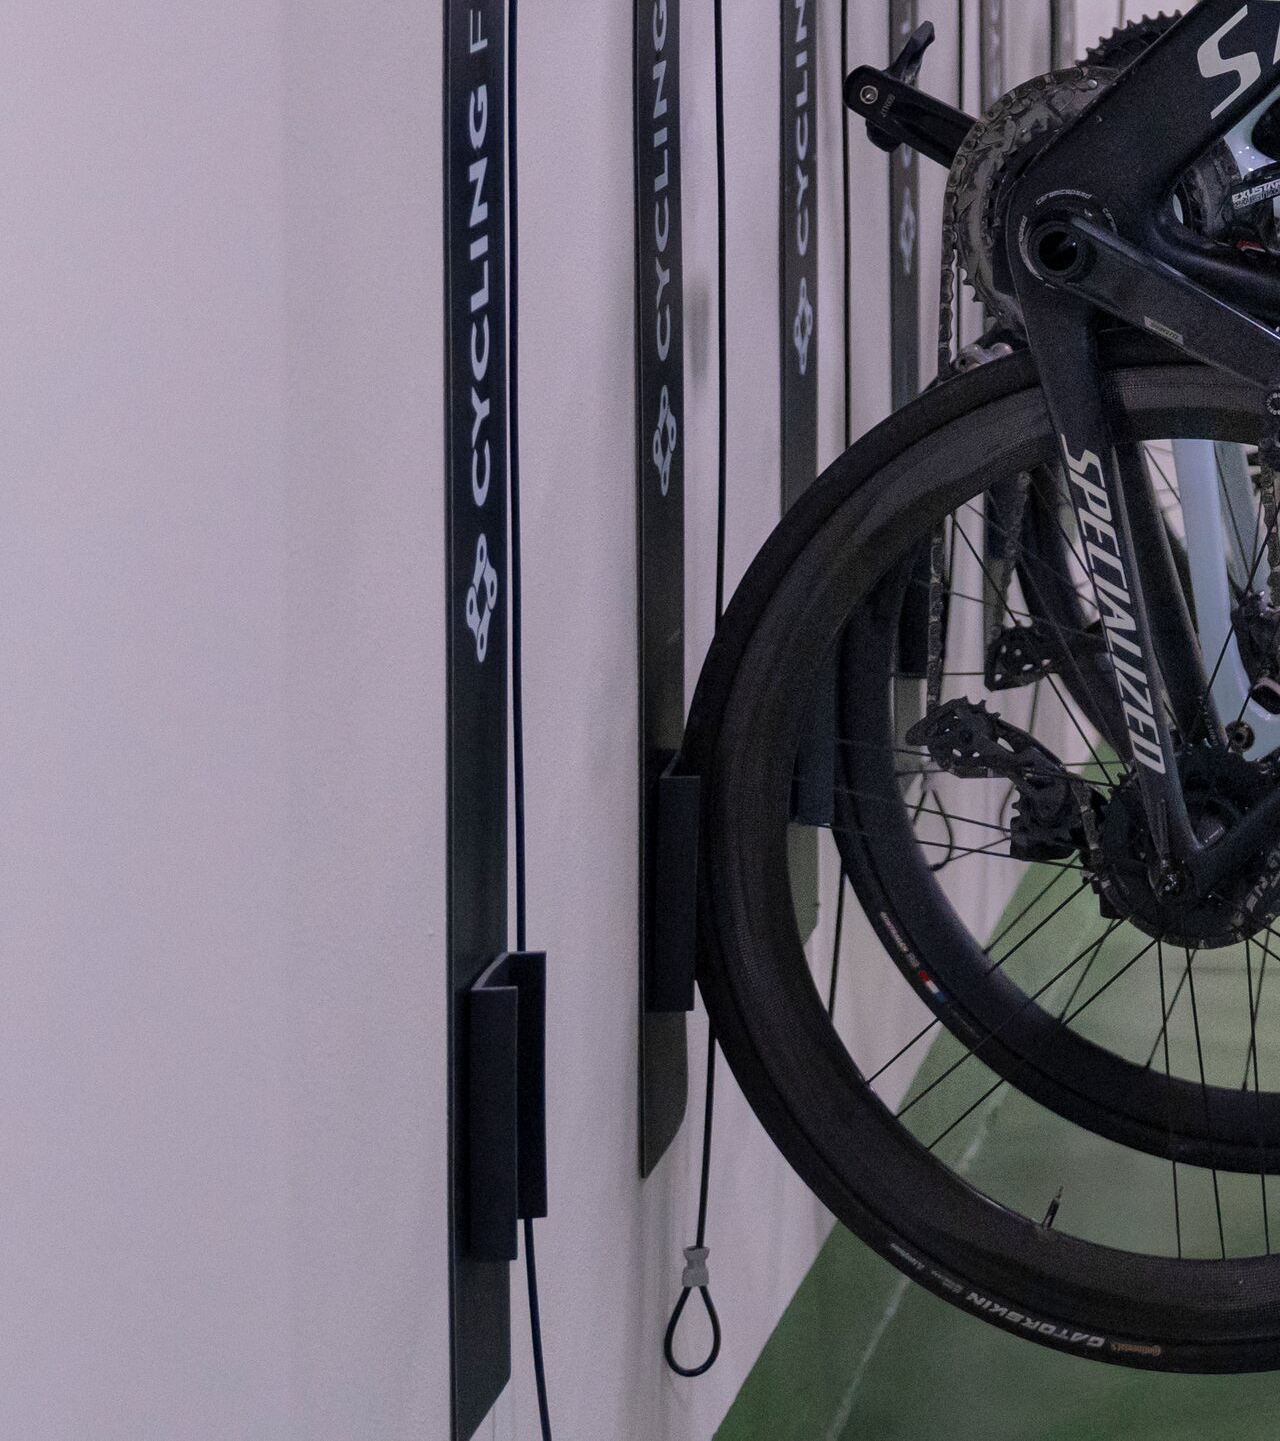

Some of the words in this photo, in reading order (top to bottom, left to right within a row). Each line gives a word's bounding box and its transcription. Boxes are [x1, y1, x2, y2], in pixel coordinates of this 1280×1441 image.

[467, 83, 491, 508] CYCLING
[1060, 433, 1167, 775] SPECIALIZED
[965, 1290, 1107, 1348] GATORSKIN
